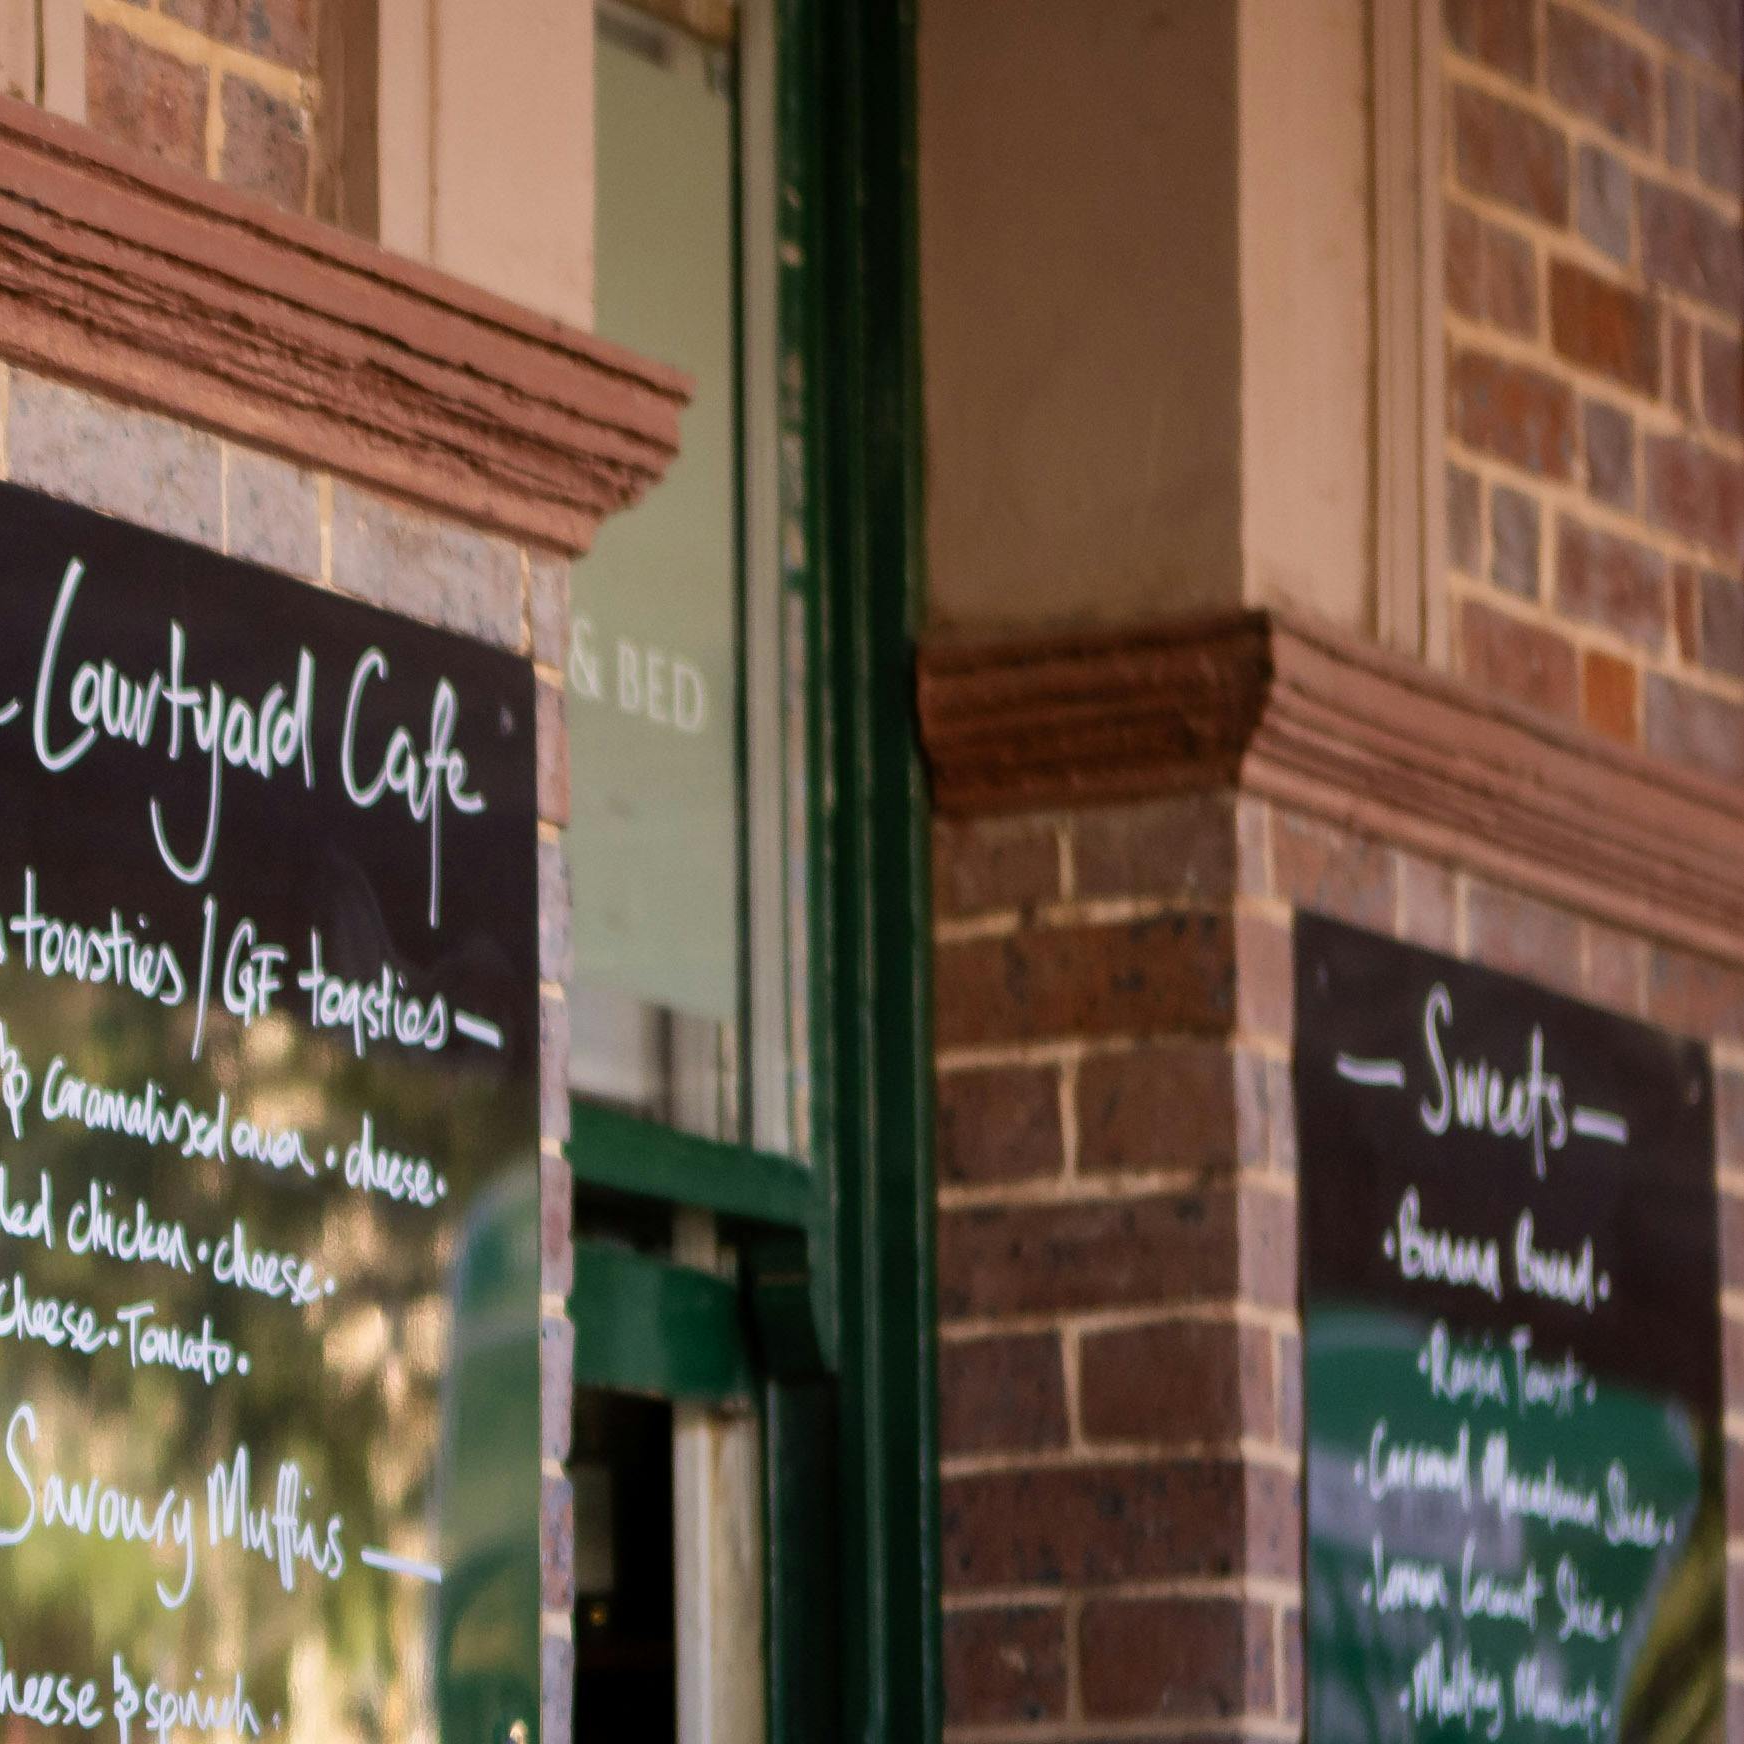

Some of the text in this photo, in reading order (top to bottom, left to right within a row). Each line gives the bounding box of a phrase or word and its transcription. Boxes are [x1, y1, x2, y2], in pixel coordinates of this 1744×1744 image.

[34, 558, 314, 884] Courtyard
[342, 647, 485, 930] Cafe
[569, 616, 704, 733] & BED
[10, 866, 184, 1006] toasties
[223, 919, 285, 1027] GF
[300, 929, 447, 1058] toasties
[1420, 981, 1567, 1181] Sweets
[66, 1179, 195, 1273] chicken
[206, 1443, 344, 1593] Muffins
